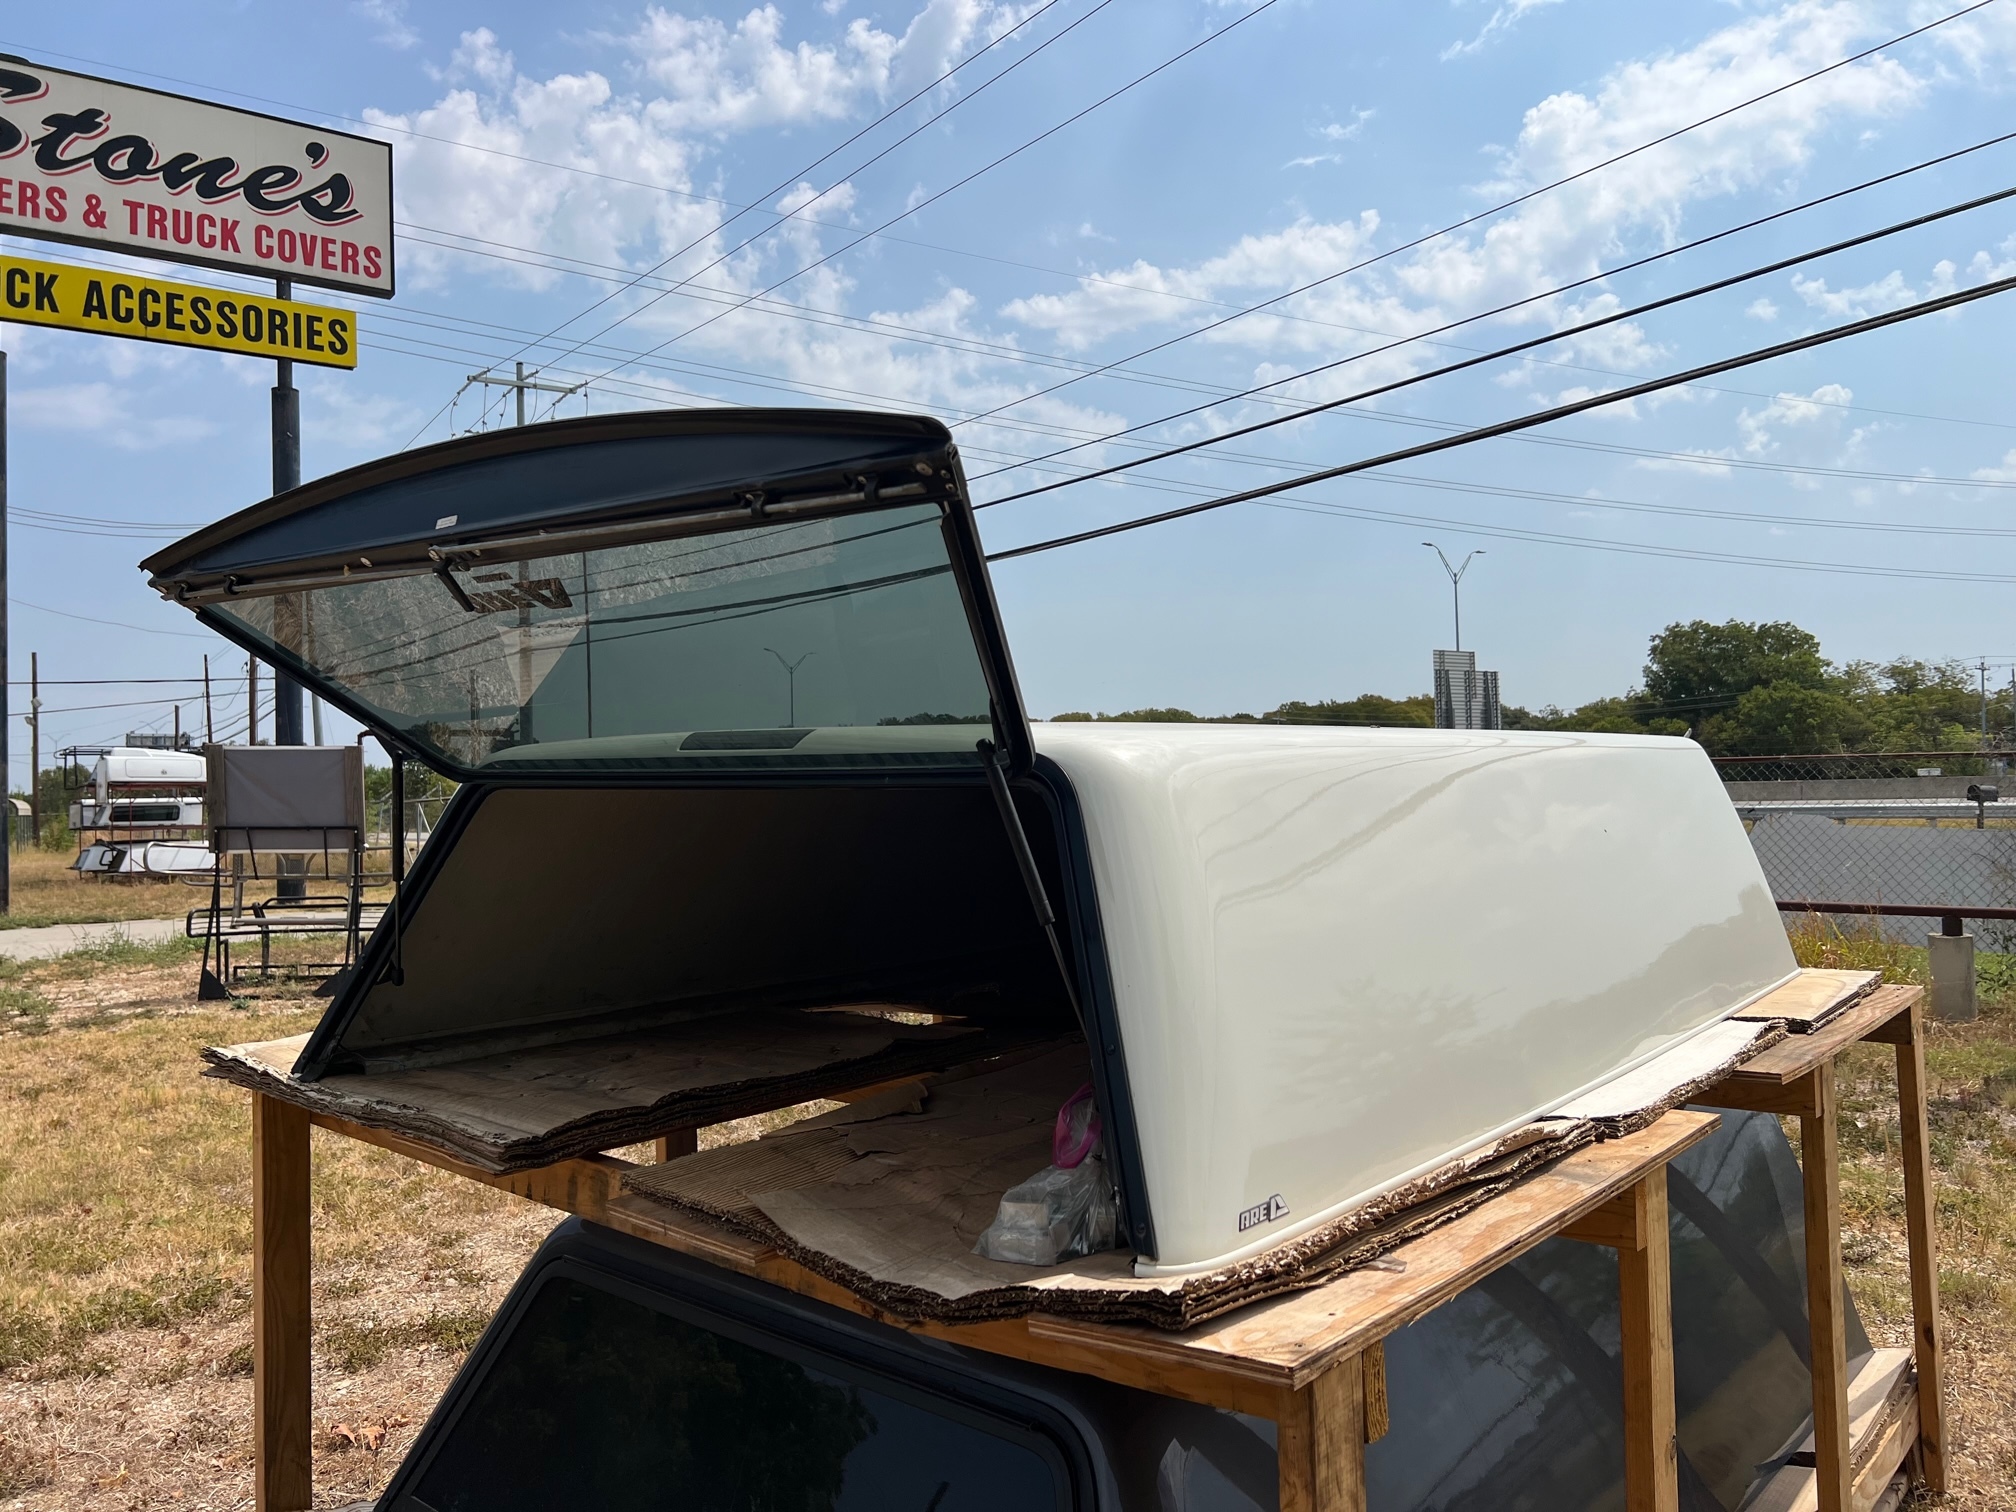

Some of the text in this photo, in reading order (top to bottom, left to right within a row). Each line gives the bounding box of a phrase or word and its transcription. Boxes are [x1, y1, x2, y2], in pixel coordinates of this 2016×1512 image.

[82, 193, 107, 230] &
[123, 199, 241, 254] TRUCK
[254, 224, 382, 279] COVERS
[0, 267, 348, 355] CK ACCESSORIES
[1240, 1203, 1268, 1230] ARE
